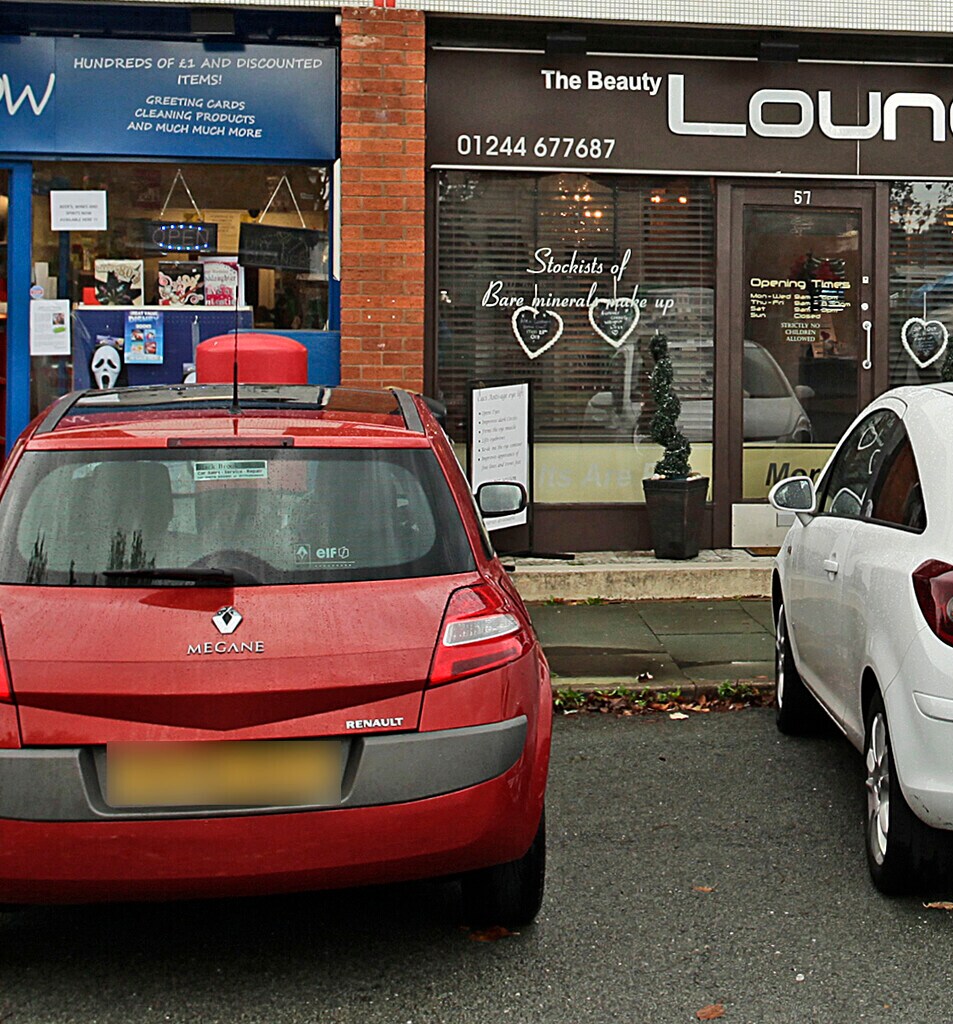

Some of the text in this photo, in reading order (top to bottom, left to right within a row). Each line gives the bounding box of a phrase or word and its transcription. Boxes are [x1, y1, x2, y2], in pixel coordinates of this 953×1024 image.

[74, 57, 323, 69] HUNDREDS OF £1 AND DISCOUNTED
[177, 74, 223, 86] ITEMS!
[541, 69, 662, 96] The Beauty
[0, 72, 55, 116] W
[146, 95, 246, 110] GREETING CARDS
[134, 108, 256, 125] CLEANING PRODUCTS
[127, 121, 263, 139] AND MUCH MUCH MORE
[457, 134, 616, 159] 01244 677687
[793, 190, 811, 205] 57
[152, 229, 209, 248] OPEN
[526, 247, 632, 282] Stockists of
[750, 277, 851, 290] Opening Times
[482, 280, 675, 316] Bare minerals make up
[316, 547, 337, 559] elf
[187, 641, 265, 655] MEGANE
[345, 716, 404, 730] RENAULT
